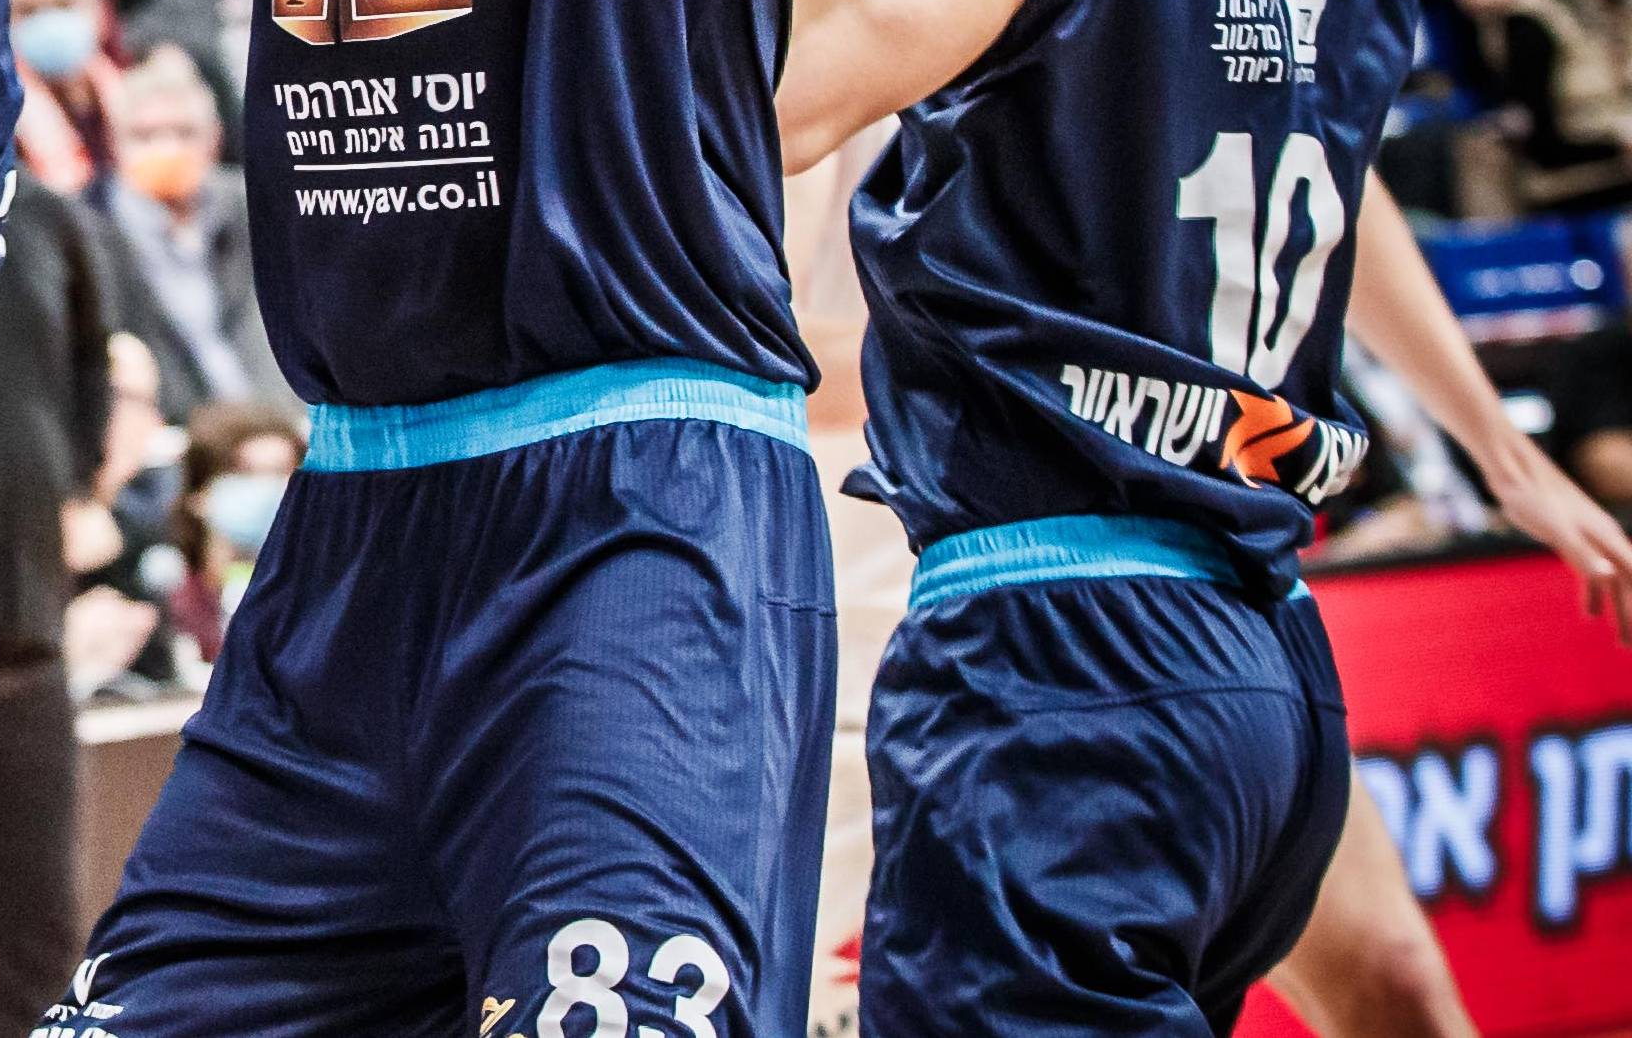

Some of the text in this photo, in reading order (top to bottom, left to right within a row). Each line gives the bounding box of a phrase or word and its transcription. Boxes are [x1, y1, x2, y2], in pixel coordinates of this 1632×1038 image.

[273, 71, 487, 120] יוסי אברהמי
[286, 120, 491, 156] בונה איכות חיים
[295, 170, 501, 225] www.yav.co.il
[1176, 131, 1345, 391] 10
[536, 917, 731, 1038] 83
